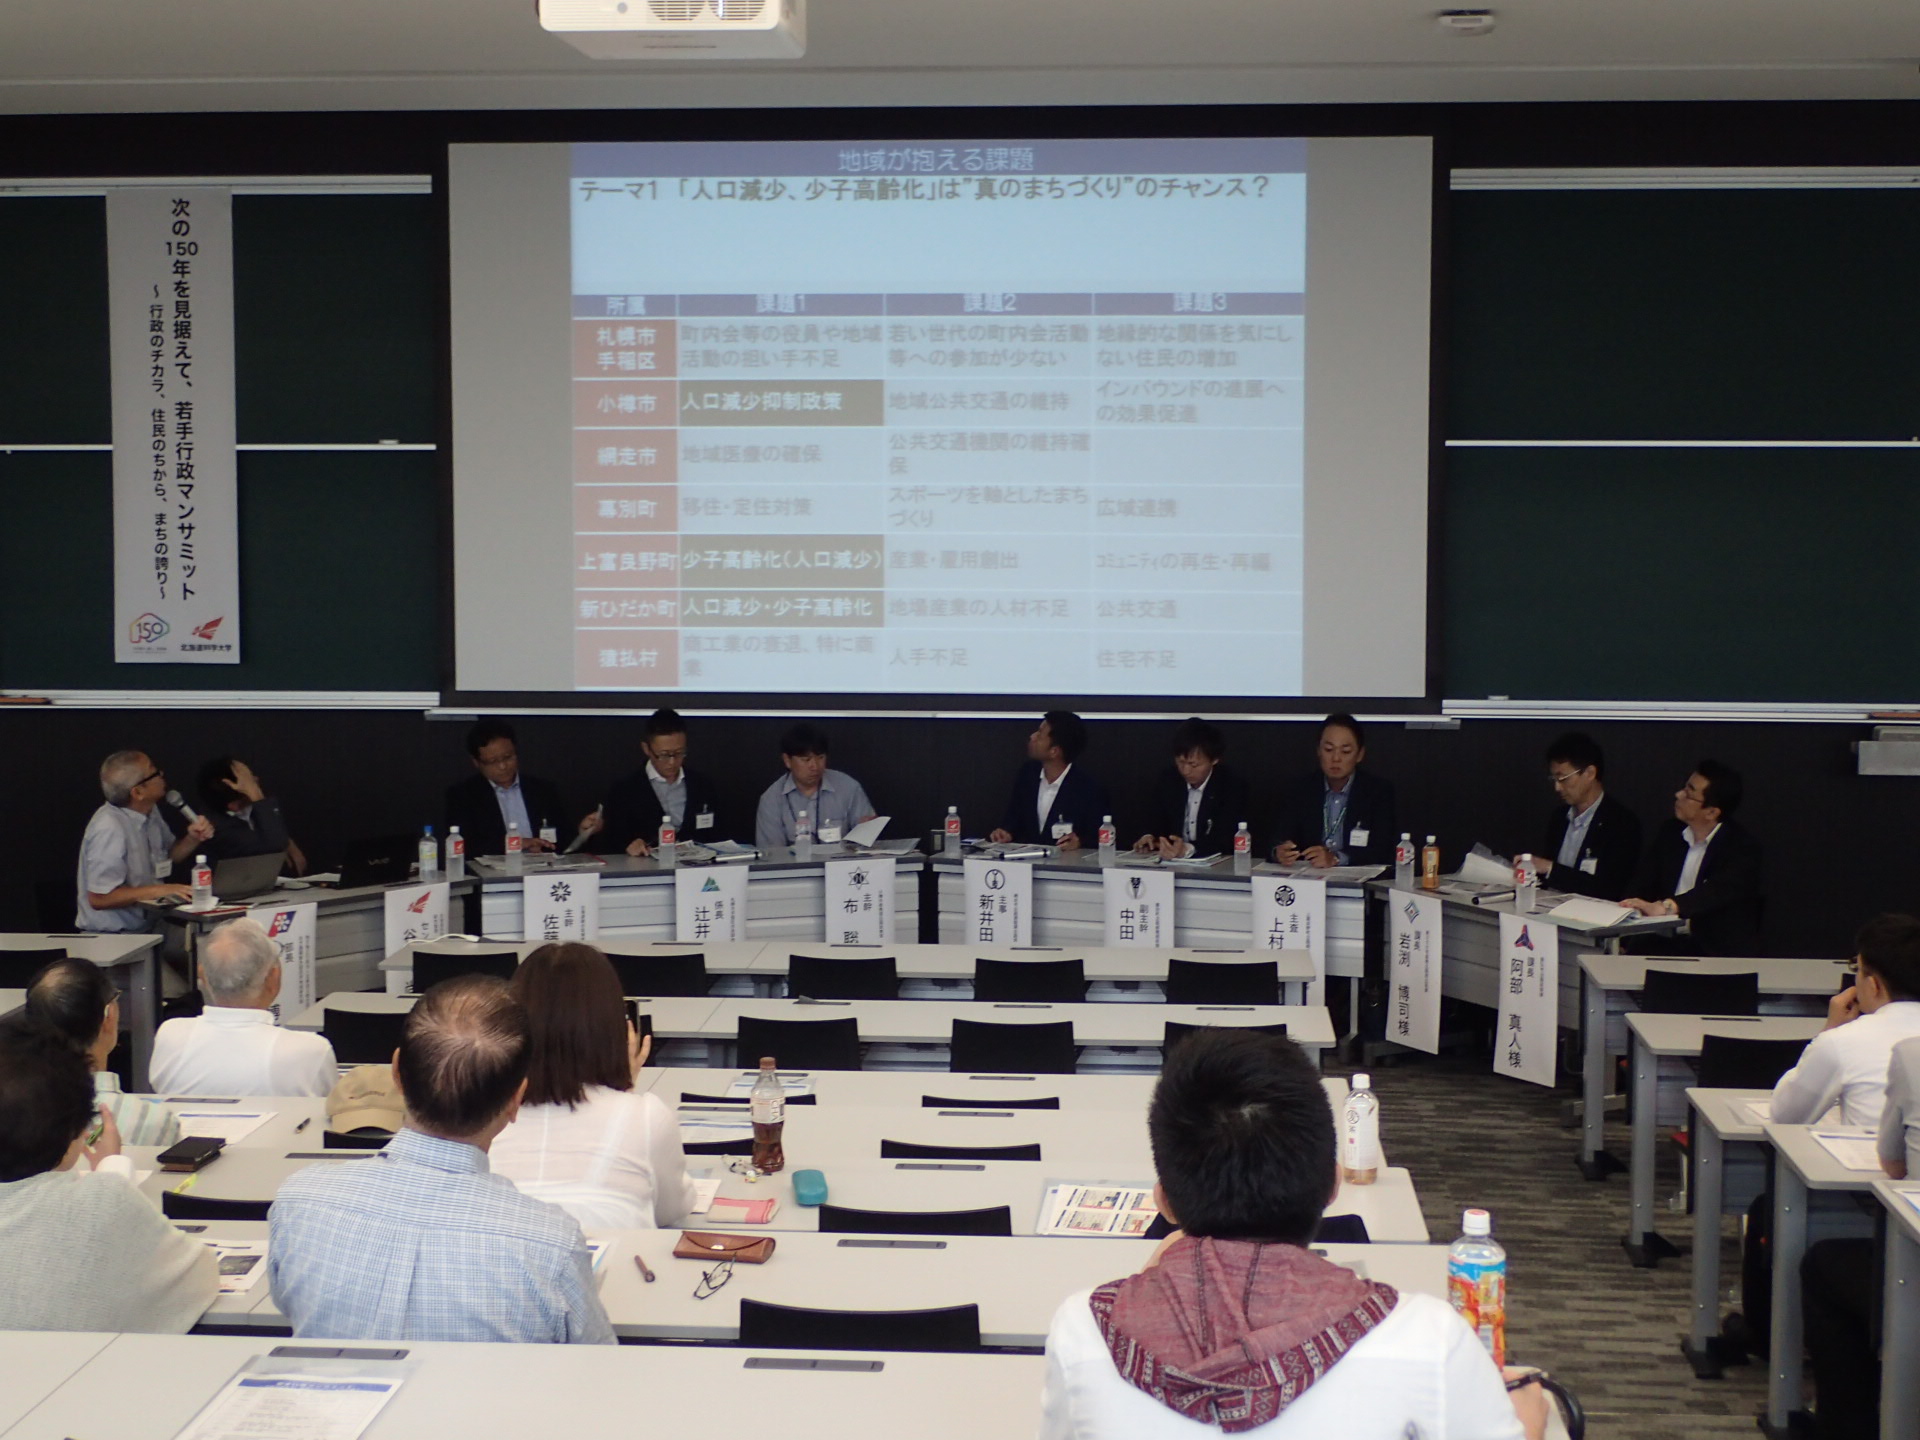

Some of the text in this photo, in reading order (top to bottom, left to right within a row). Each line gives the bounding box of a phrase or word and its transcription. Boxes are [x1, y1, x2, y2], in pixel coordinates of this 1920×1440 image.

[837, 147, 1034, 172] 地域が抱える課題
[605, 296, 646, 315] 所属
[756, 294, 805, 313] 課題1
[963, 293, 1017, 312] 課題2
[1174, 292, 1227, 312] 課題3
[597, 326, 656, 346] 札幌市
[681, 324, 882, 343] 町内会等の役員や地域
[888, 323, 1089, 343] 若い世代の町内会活動
[597, 352, 656, 371] 手稲区
[681, 349, 840, 368] 活動の担い手不足
[888, 348, 1067, 368] 等への参加が少ない
[1096, 348, 1238, 368] ない住民の増加
[597, 394, 657, 414] 小樽市
[682, 392, 842, 411] 人口減少抑制政策
[888, 391, 1069, 411] 地域公共交通の維持
[598, 447, 657, 466] 網走市
[888, 485, 1088, 505] スポーツを軸としたまち
[598, 499, 657, 518] 幕別町
[682, 497, 813, 517] 移住・定住対策
[889, 510, 934, 528] づくり
[578, 552, 678, 572] 上富良野町
[889, 550, 1018, 570] 産業・雇用創出
[579, 599, 676, 619] 新ひだか町
[684, 598, 872, 617] 人口減少・少子高齢化
[888, 599, 1069, 618] 地場産業の人材不足
[1097, 600, 1177, 619] 公共交通
[889, 647, 968, 666] 人手不足
[1097, 649, 1177, 669] 住宅不足
[694, 905, 711, 939] 辻井
[979, 893, 995, 942] 新井田
[1120, 907, 1134, 940] 中田
[1268, 916, 1285, 950] 上村
